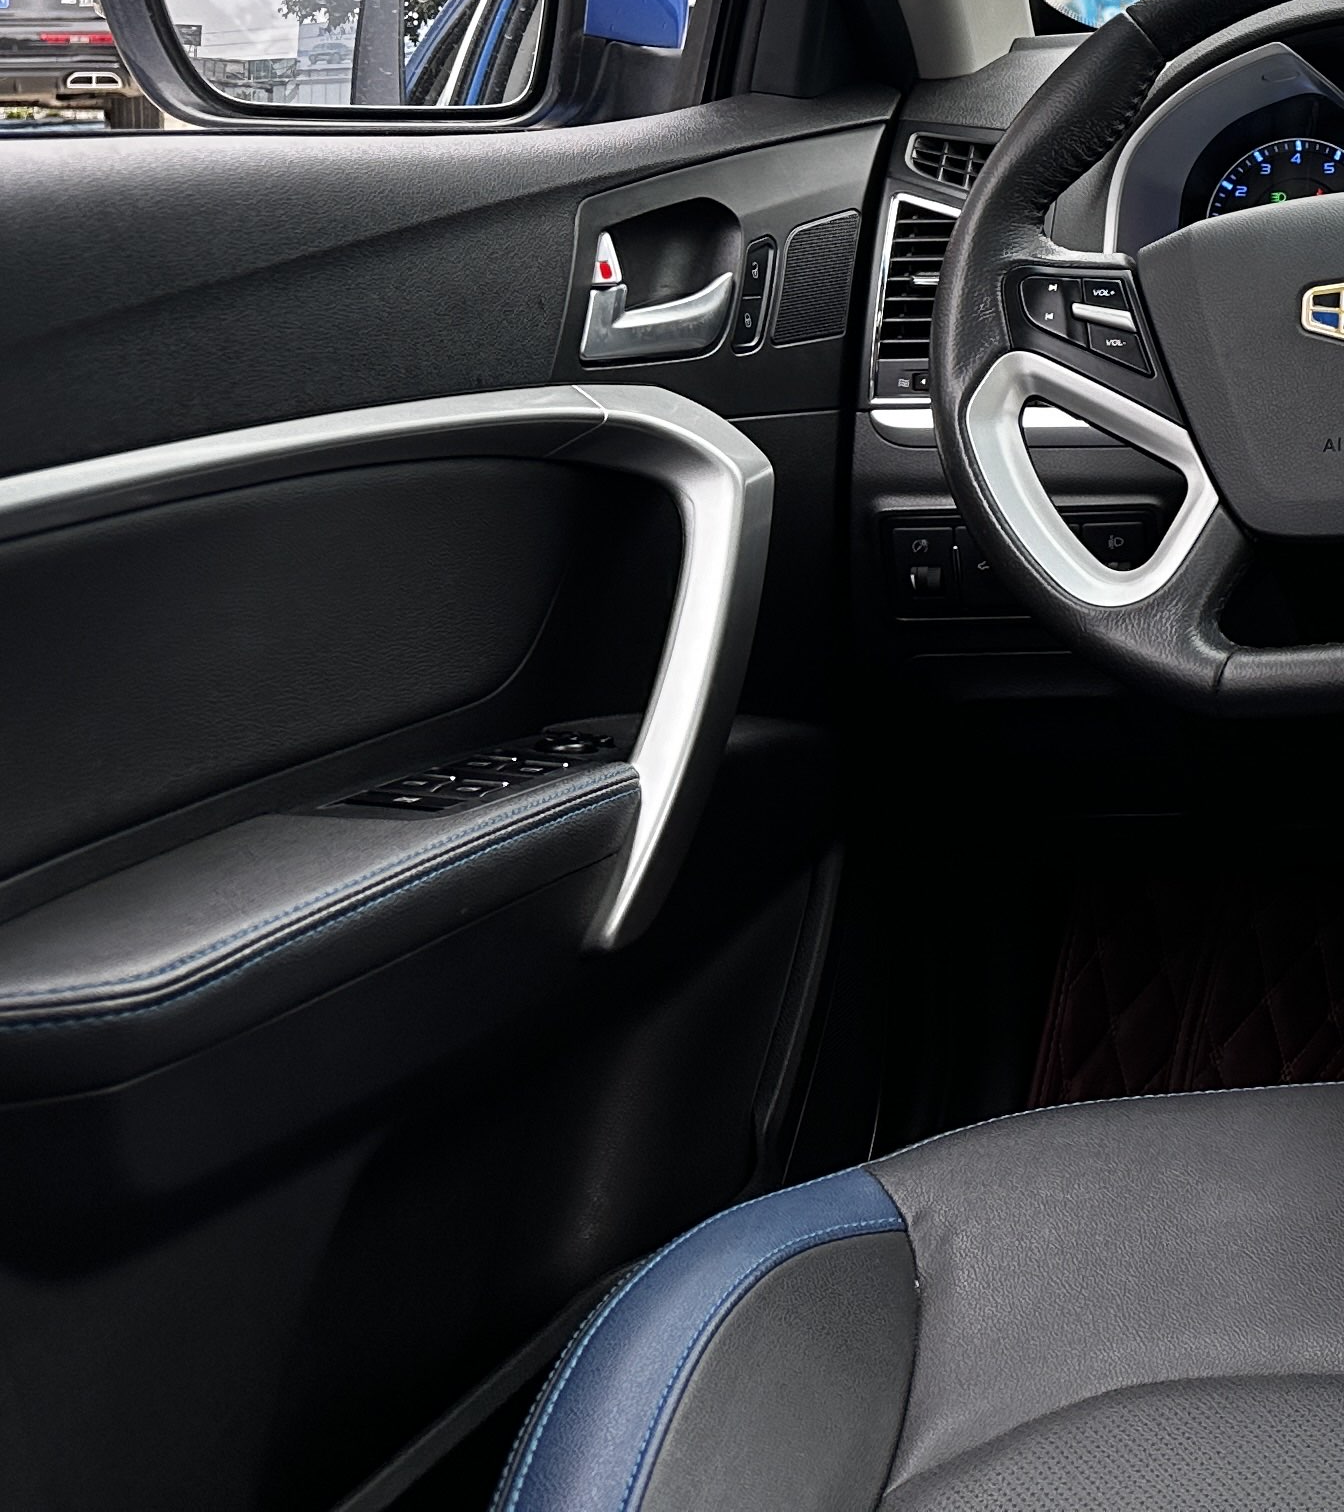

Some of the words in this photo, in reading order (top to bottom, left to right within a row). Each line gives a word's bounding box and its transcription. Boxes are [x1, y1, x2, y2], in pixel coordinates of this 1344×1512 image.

[1291, 153, 1300, 164] 4
[1260, 164, 1271, 175] 3
[1324, 163, 1335, 174] 5
[1235, 186, 1248, 197] 2
